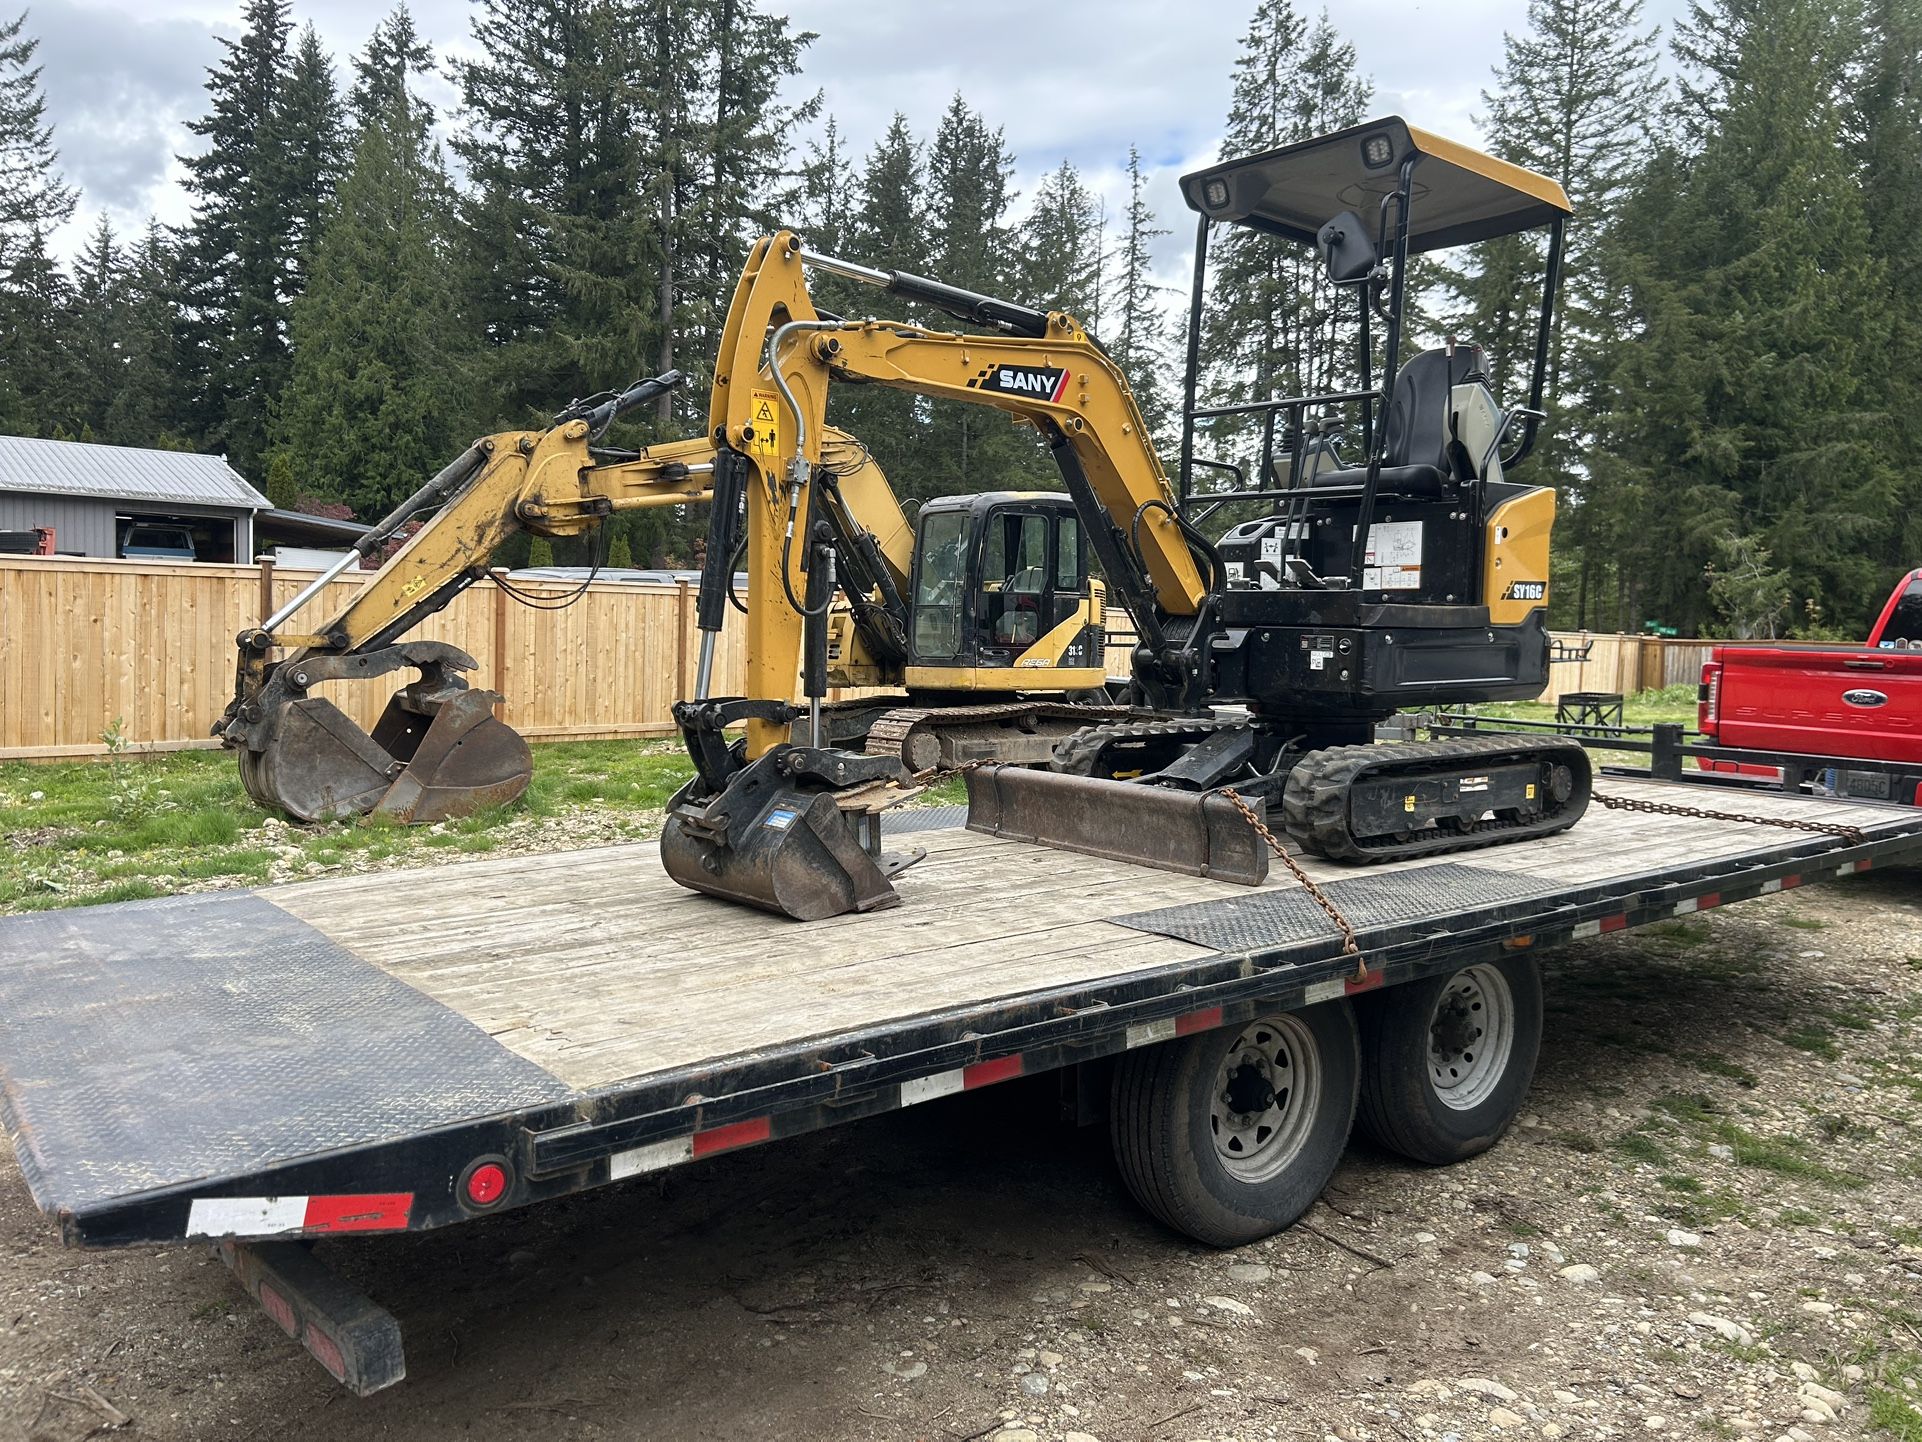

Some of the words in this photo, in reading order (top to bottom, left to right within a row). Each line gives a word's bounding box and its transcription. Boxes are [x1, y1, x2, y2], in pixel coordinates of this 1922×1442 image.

[999, 369, 1056, 393] SANY
[1513, 584, 1543, 599] SY16C
[1736, 706, 1874, 725] SUPER
